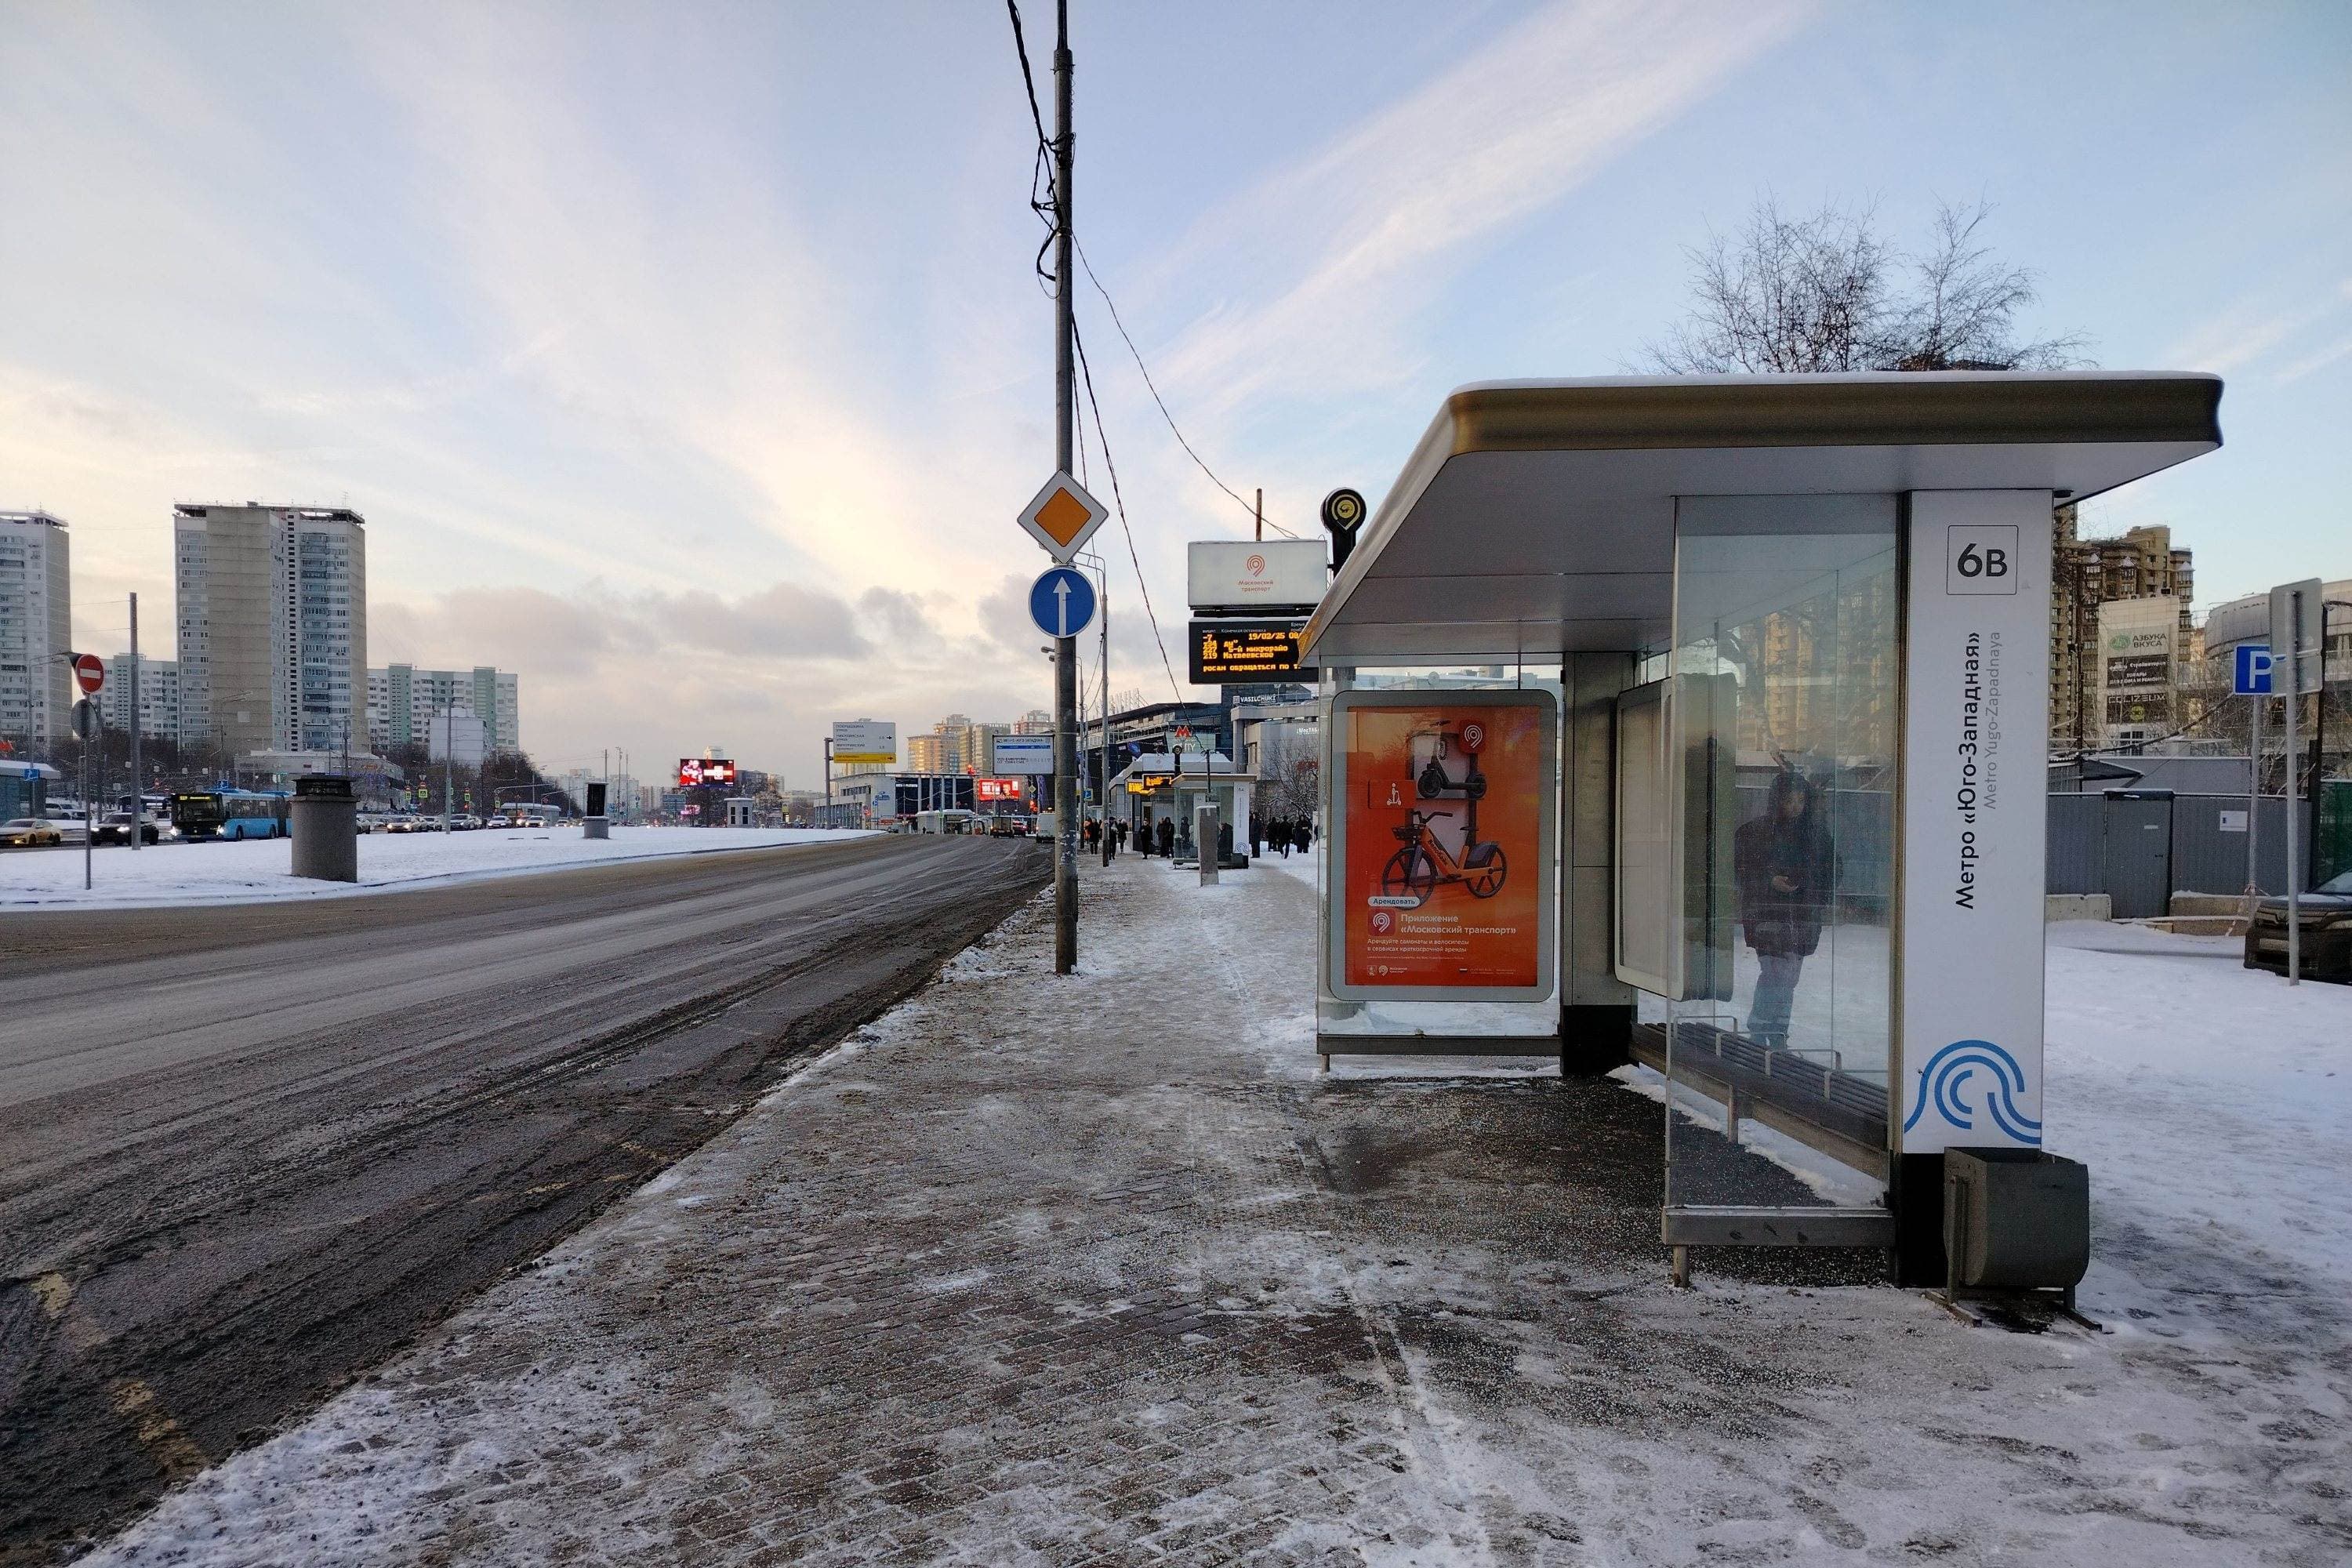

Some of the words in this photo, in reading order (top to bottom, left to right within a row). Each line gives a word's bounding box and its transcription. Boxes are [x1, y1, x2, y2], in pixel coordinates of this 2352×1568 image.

[1957, 543, 2008, 578] 6В
[2249, 651, 2273, 689] P
[1240, 694, 1276, 702] VASILCHUKI
[1984, 631, 2002, 757] Yugo-Zapadnaya
[1957, 632, 1982, 824] «Юго-Западная»
[1984, 761, 1997, 810] Metro
[1955, 830, 1980, 909] Метро
[1400, 914, 1459, 924] Приложение
[1400, 924, 1463, 934] «Московский
[1465, 927, 1517, 935] транспорт»
